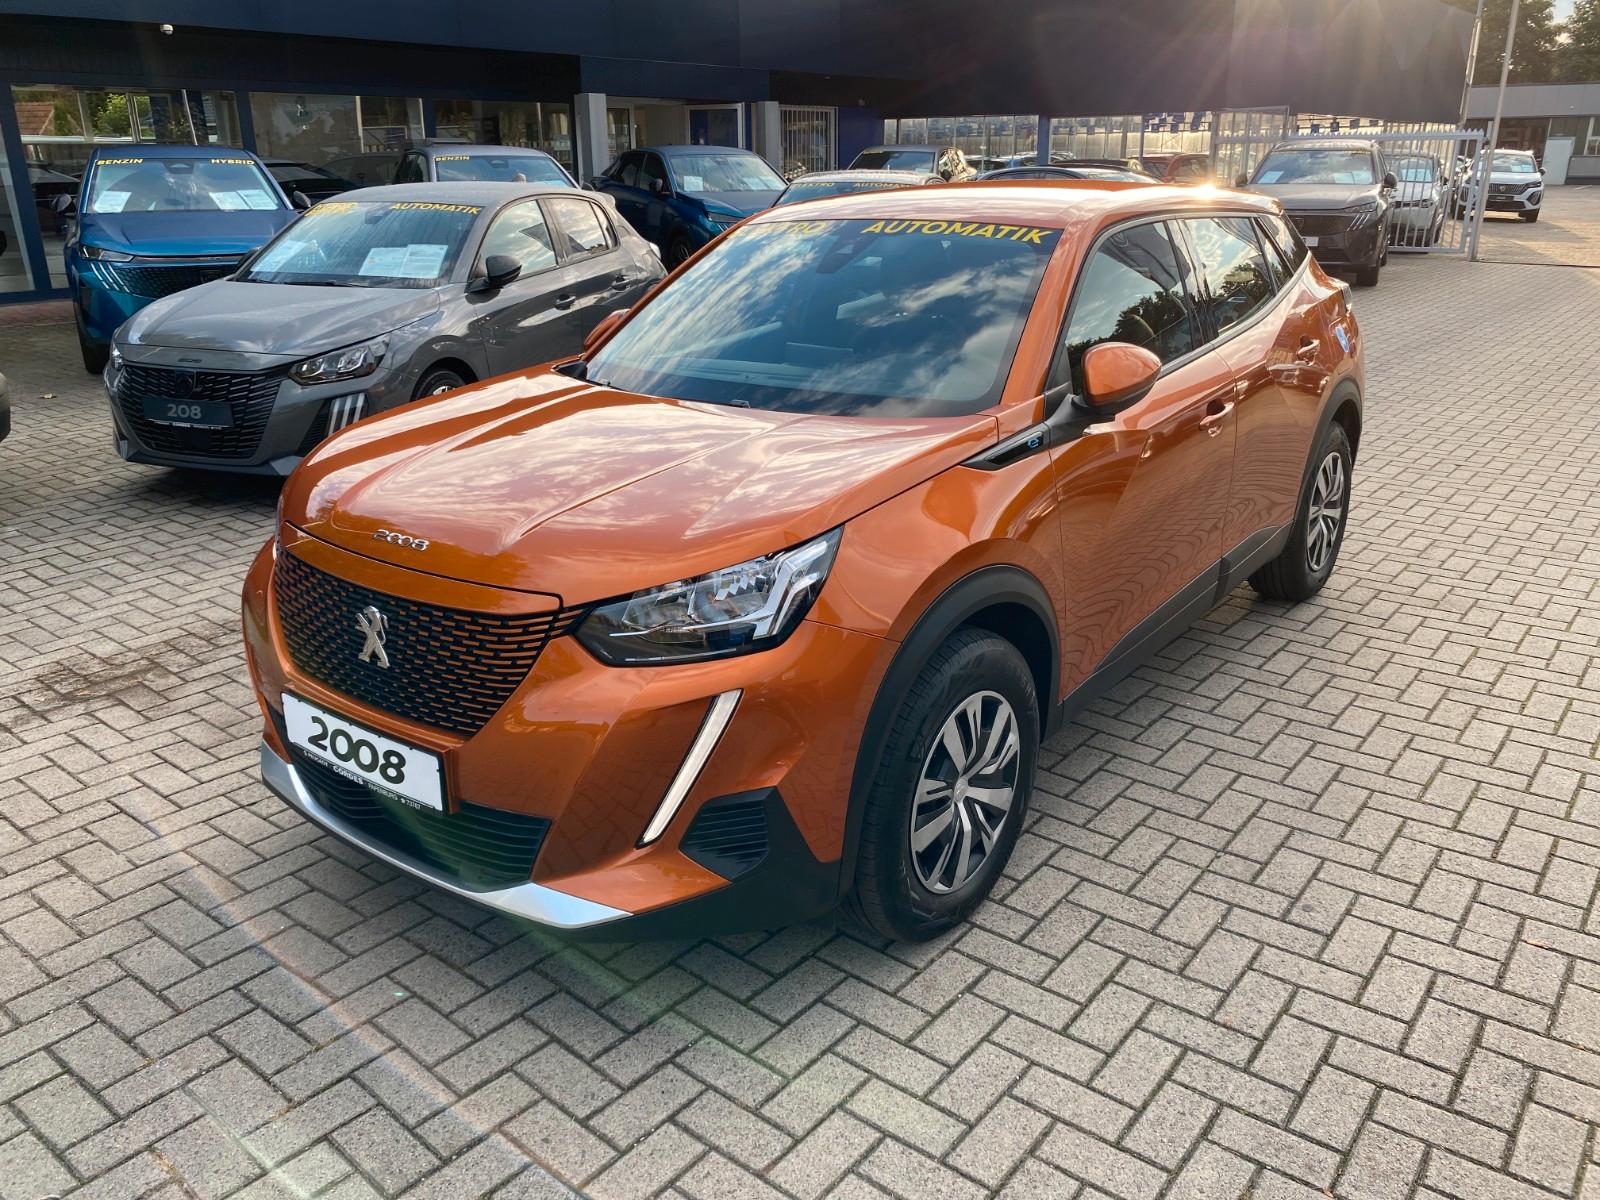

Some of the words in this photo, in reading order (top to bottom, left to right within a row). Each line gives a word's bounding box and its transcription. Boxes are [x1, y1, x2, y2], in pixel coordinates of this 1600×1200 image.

[96, 158, 143, 166] BENZIN
[389, 202, 482, 215] AUTOMATIK
[860, 220, 1054, 244] AUTOMATIK
[167, 403, 202, 419] 208
[373, 528, 430, 551] 2008
[307, 715, 407, 785] 2008
